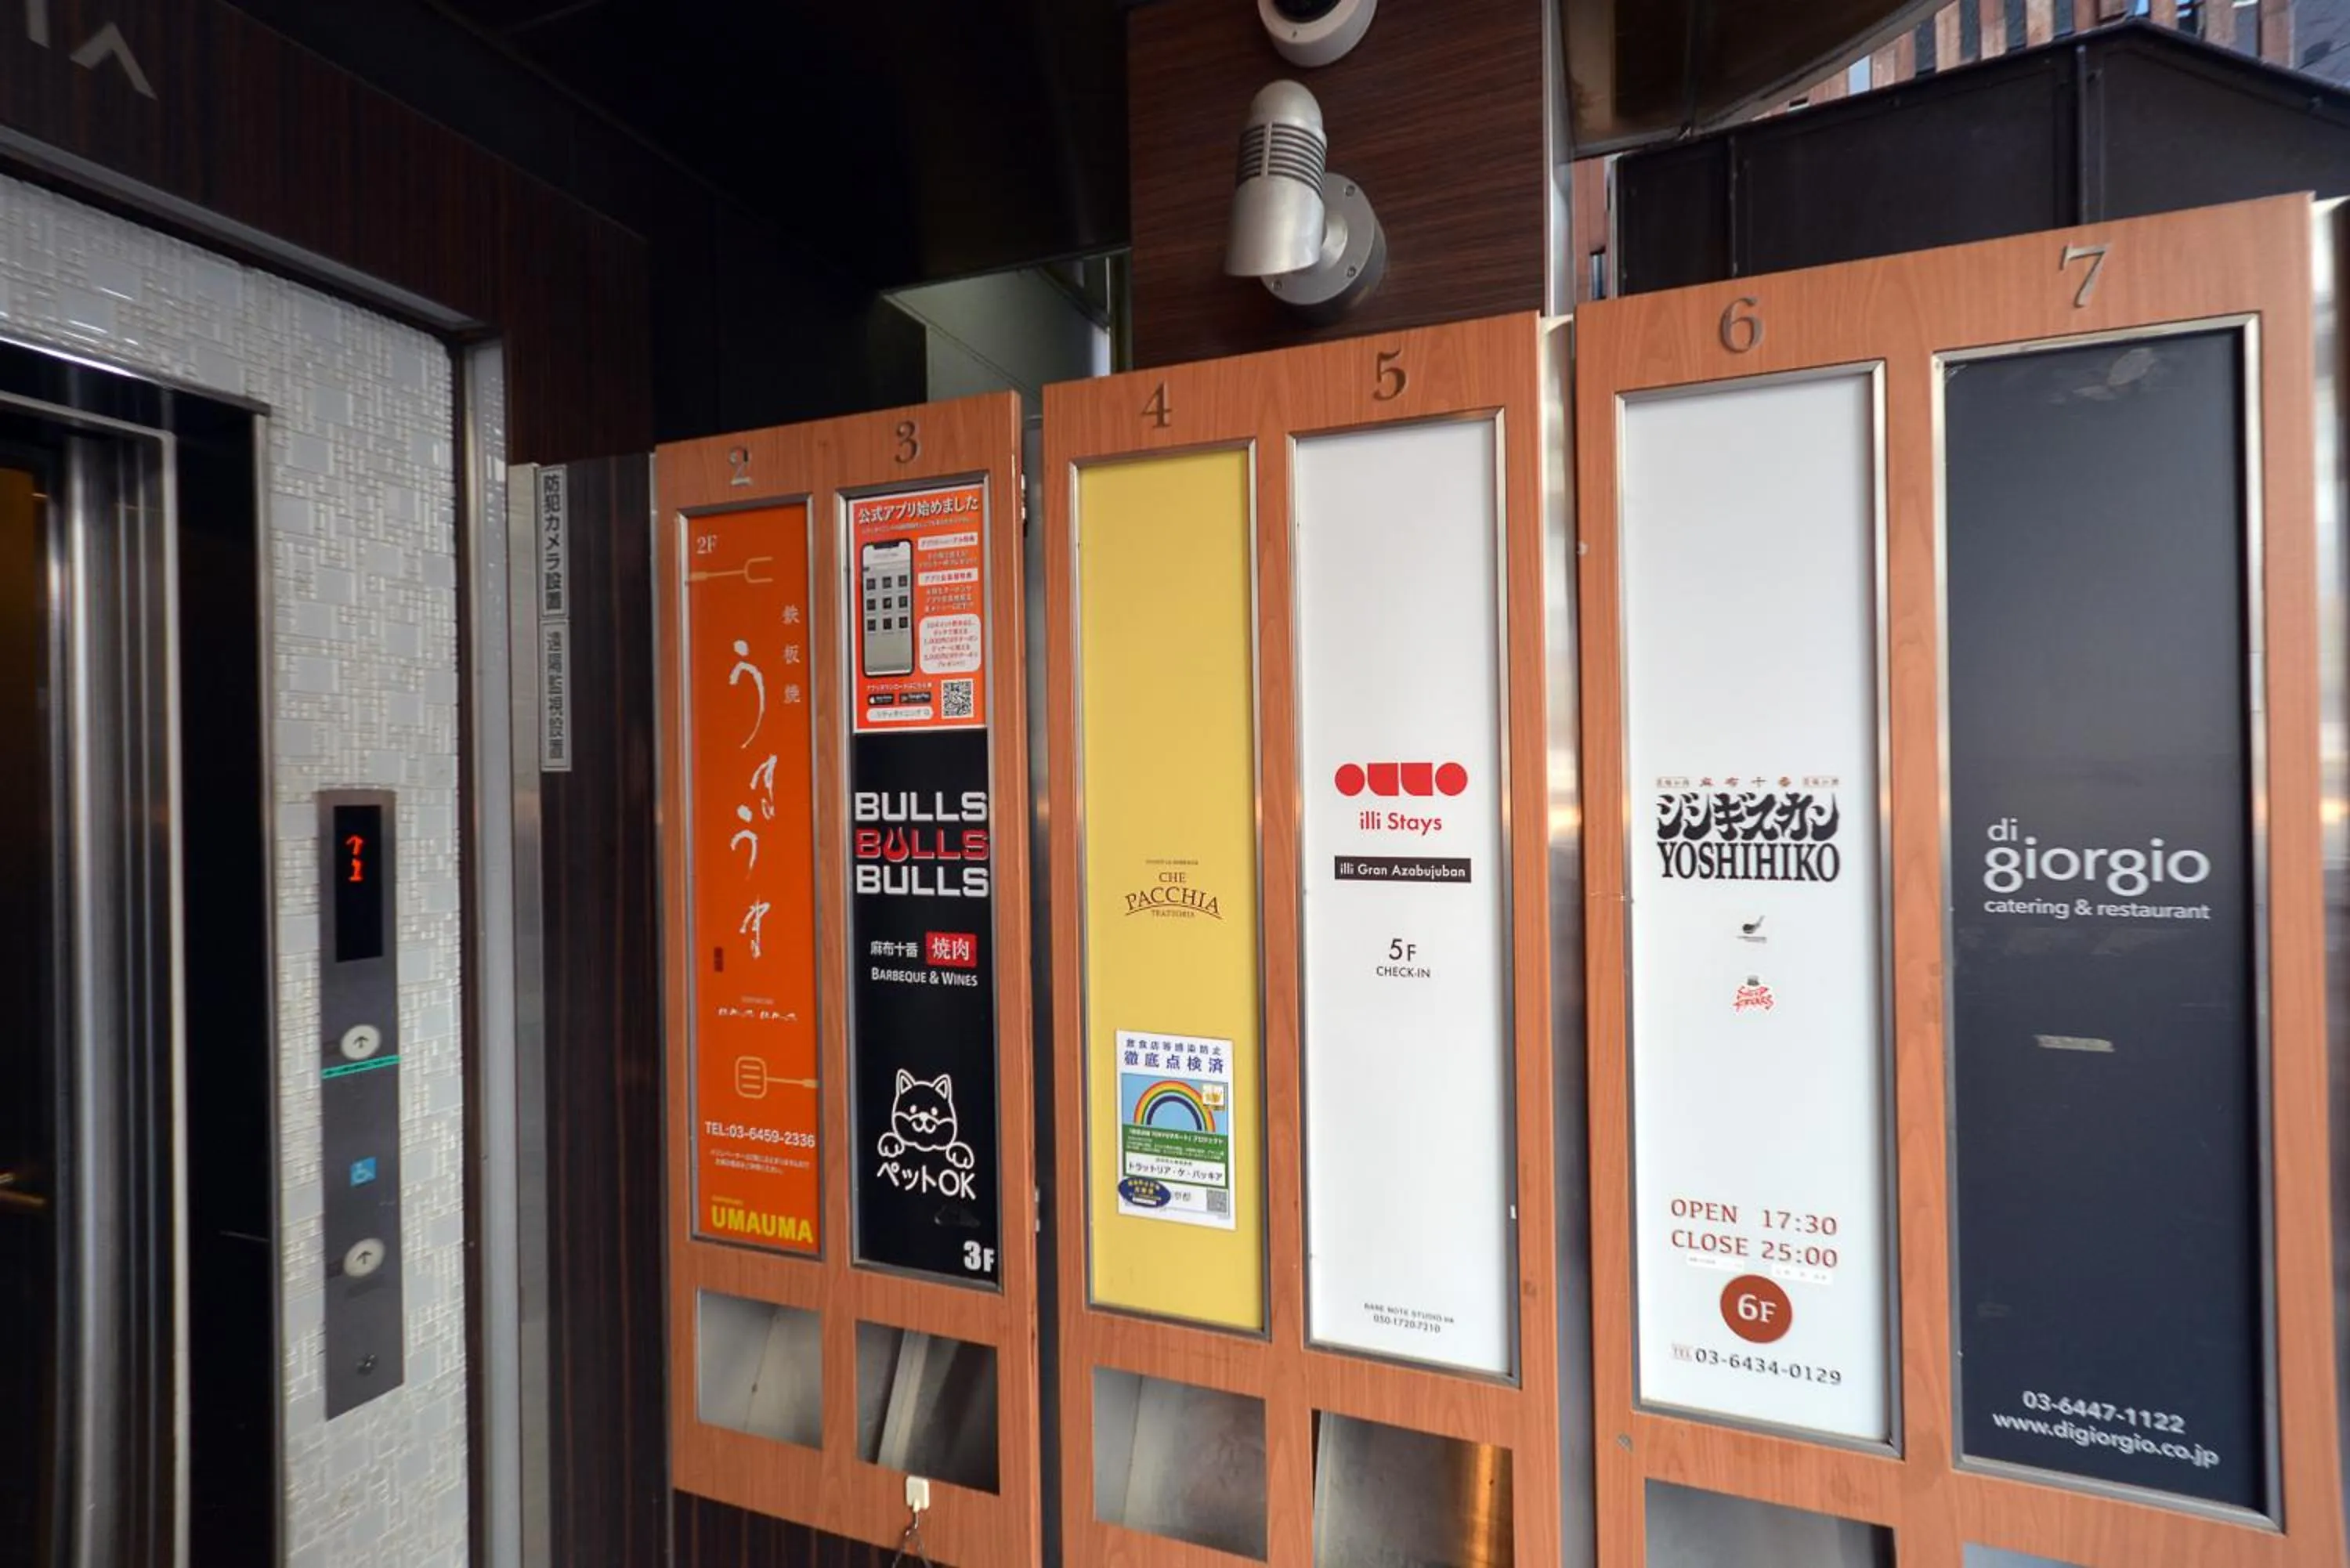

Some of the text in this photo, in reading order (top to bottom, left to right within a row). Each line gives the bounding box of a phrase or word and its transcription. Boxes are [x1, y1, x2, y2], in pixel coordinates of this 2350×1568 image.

[2059, 241, 2112, 309] 7
[1719, 296, 1764, 353] 6
[1372, 346, 1408, 401] 5
[1139, 382, 1173, 429] 4
[893, 420, 920, 464] 3
[728, 446, 753, 486] 2
[858, 494, 979, 524] 公式アプリ始めました
[696, 534, 718, 555] 2F
[855, 791, 987, 822] BULLS
[1359, 811, 1443, 836] illi Stays
[1655, 791, 1840, 842] ジンギスカン
[855, 826, 989, 862] BULLS
[1987, 817, 2019, 842] di
[1159, 872, 1187, 883] CHE
[1340, 862, 1466, 880] illi Gran Azabujuban
[1656, 840, 1841, 883] YOSHIHIKO
[1983, 836, 2211, 897] giorgio
[855, 864, 989, 898] BULLS
[1124, 886, 1221, 916] PACCHIA
[1983, 898, 2212, 919] catering & restaurant
[870, 937, 970, 961] 麻布十番 焼肉
[1388, 938, 1417, 962] 5F
[929, 970, 939, 985] &
[1376, 966, 1430, 978] CHECK-IN
[1124, 1050, 1224, 1074] 徹底点検済
[1126, 1038, 1222, 1056] 飲食店等感染防止
[877, 1161, 976, 1200] ペットOK
[711, 1204, 814, 1244] UMAUMA
[1670, 1198, 1838, 1236] OPEN 17:30
[964, 1240, 995, 1272] 3F
[1671, 1228, 1838, 1268] CLOSE 25:00
[1736, 1292, 1777, 1323] 6F
[1694, 1347, 1842, 1386] 03-6434-0129
[2022, 1389, 2186, 1435] 03-6447-1122
[1991, 1412, 2220, 1469] www.digiorgio.co.jp
